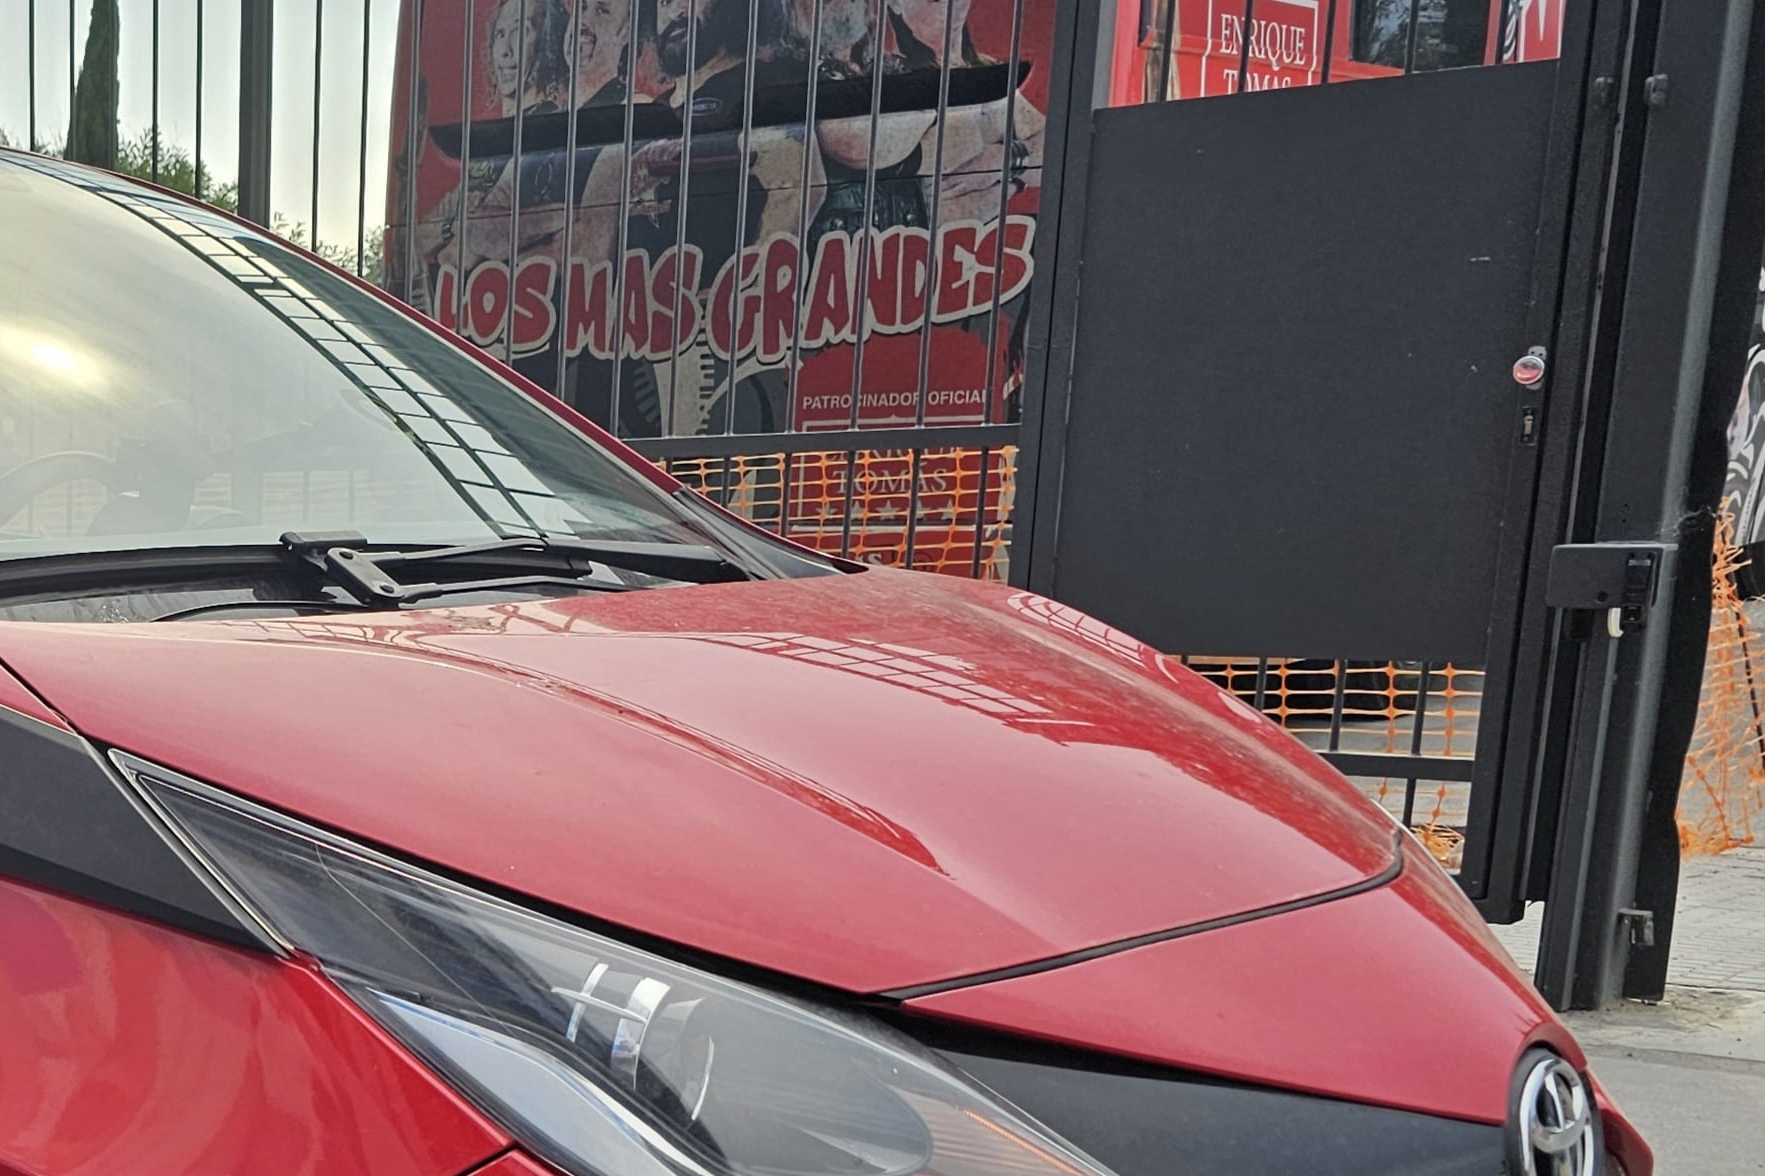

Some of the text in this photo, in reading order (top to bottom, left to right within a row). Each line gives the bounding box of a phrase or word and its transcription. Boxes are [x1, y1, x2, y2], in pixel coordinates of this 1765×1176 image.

[1219, 13, 1306, 71] ENRIQUE
[436, 214, 1036, 365] LOS MAS GRANDES
